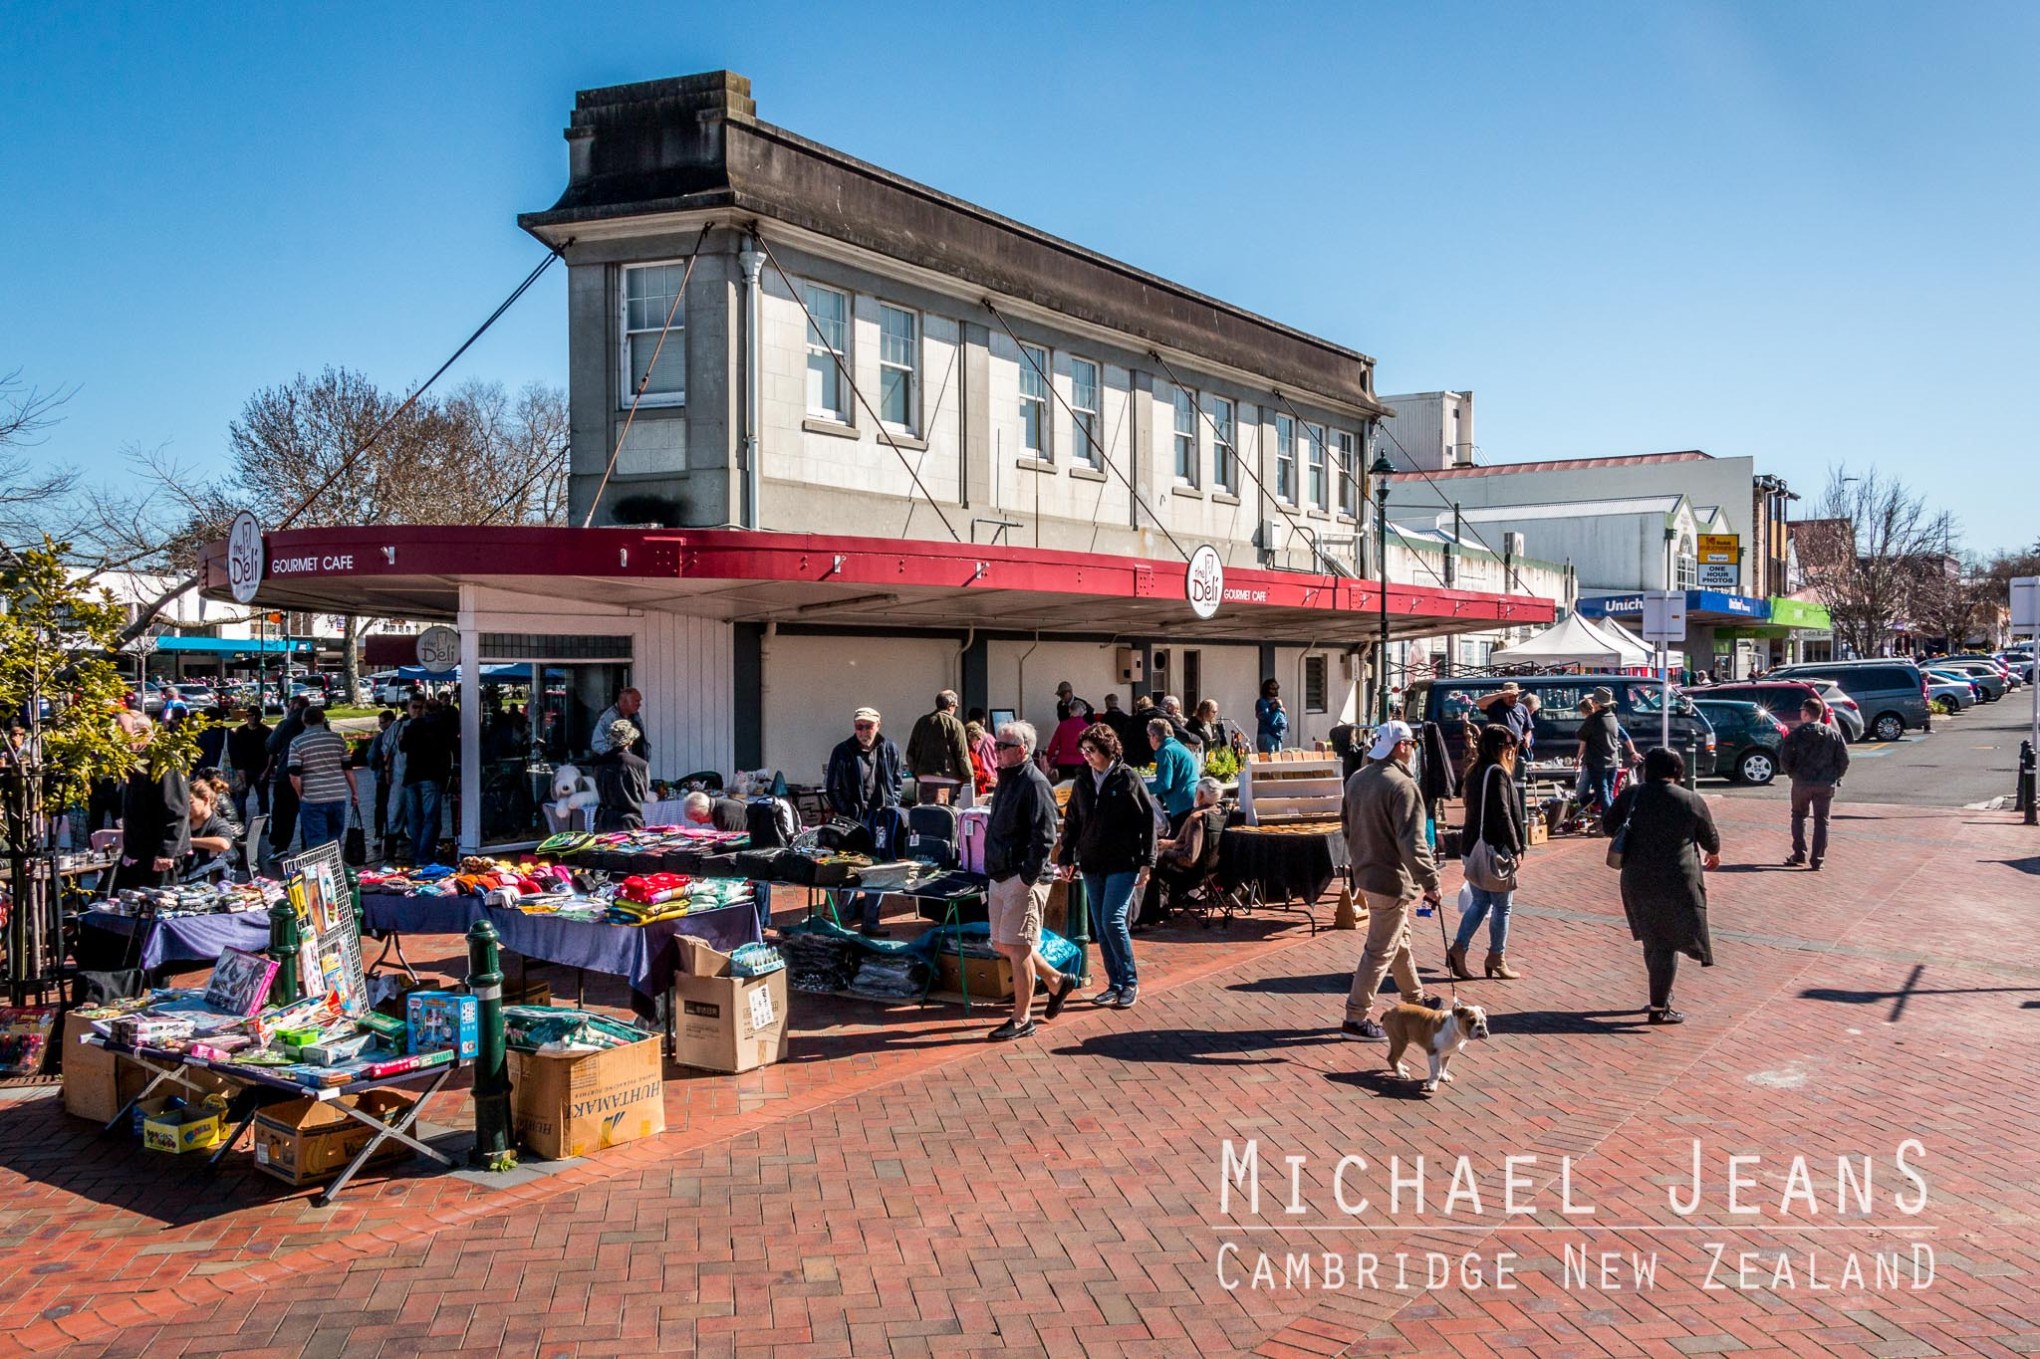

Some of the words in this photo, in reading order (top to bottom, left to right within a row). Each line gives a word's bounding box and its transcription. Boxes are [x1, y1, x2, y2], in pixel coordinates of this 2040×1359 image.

[233, 541, 243, 556] the
[231, 547, 258, 585] Deli
[272, 557, 318, 573] GOURMET
[322, 555, 353, 570] CAFE
[1192, 576, 1219, 602] Deli
[1223, 589, 1251, 601] GOURMET
[1252, 590, 1267, 602] CAFE
[421, 644, 455, 662] Deli
[565, 1080, 660, 1120] HUHTAMAKI
